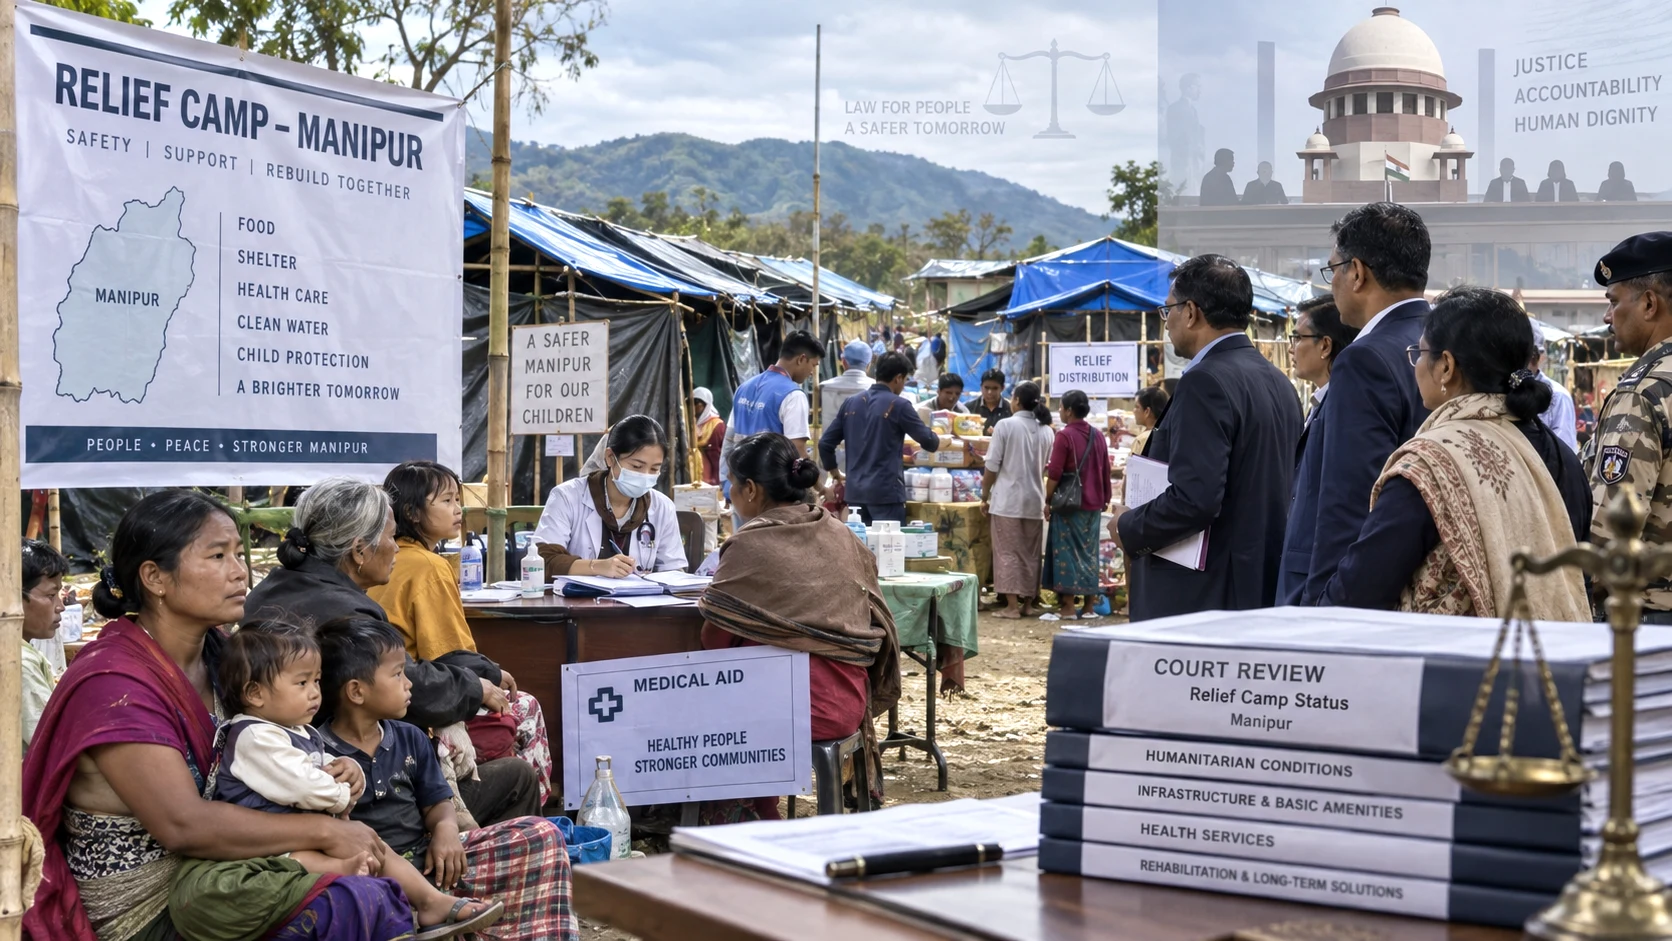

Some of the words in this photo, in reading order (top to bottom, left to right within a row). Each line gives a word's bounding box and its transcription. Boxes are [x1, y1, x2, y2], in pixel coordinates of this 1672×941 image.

[55, 62, 171, 122] RELIEF
[180, 88, 269, 141] CAMP
[297, 111, 423, 171] MANIPUR
[66, 128, 132, 153] SAFETY
[164, 144, 238, 171] SUPPORT
[266, 162, 330, 186] REBUILD
[337, 174, 411, 201] TOGETHER
[238, 216, 275, 236] FOOD
[237, 249, 297, 271] SHELTER
[95, 287, 160, 307] MANIPUR
[237, 281, 289, 301] HEALTH
[295, 287, 329, 305] CARE
[237, 314, 281, 332] CLEAN
[286, 318, 329, 336] WATER
[526, 333, 536, 350] A
[543, 330, 590, 349] SAFER
[237, 346, 280, 364] CHILD
[286, 349, 369, 369] PROTECTION
[524, 356, 592, 375] MANIPUR
[1074, 354, 1113, 367] RELIEF
[1058, 371, 1129, 383] DISTRIBUTION
[236, 379, 246, 394] A
[252, 379, 321, 398] BRIGHTER
[326, 383, 400, 401] TOMORROW
[526, 383, 553, 400] FOR
[560, 381, 590, 398] OUR
[522, 407, 594, 425] CHILDREN
[87, 438, 142, 452] PEOPLE
[165, 438, 210, 452] PEACE
[232, 439, 303, 453] STRONGER
[309, 441, 368, 454] MANIPUR
[633, 672, 710, 693] MEDICAL
[714, 669, 744, 686] AID
[1154, 658, 1230, 679] COURT
[1236, 662, 1326, 684] REVIEW
[1189, 686, 1237, 704] Relief
[1240, 689, 1289, 710] Camp
[1294, 692, 1349, 711] Status
[1230, 712, 1293, 733] Manipur
[647, 734, 699, 753] HEALTHY
[702, 730, 748, 748] PEOPLE
[634, 755, 698, 774] STRONGER
[701, 747, 786, 768] COMMUNITIES
[1145, 749, 1255, 770] HUMANITARIAN
[1260, 758, 1353, 778] CONDITIONS
[1137, 784, 1256, 807] INFRASTRUCTURE
[1260, 795, 1271, 808] &
[1275, 796, 1319, 812] BASIC
[1322, 800, 1404, 820] AMENITIES
[1140, 822, 1197, 840] HEALTH
[1201, 828, 1275, 848] SERVICES
[1140, 859, 1238, 881] REHABILITATION
[1240, 870, 1250, 883] &
[1253, 872, 1327, 891] LONG-TERM
[1330, 880, 1404, 900] SOLUTIONS
